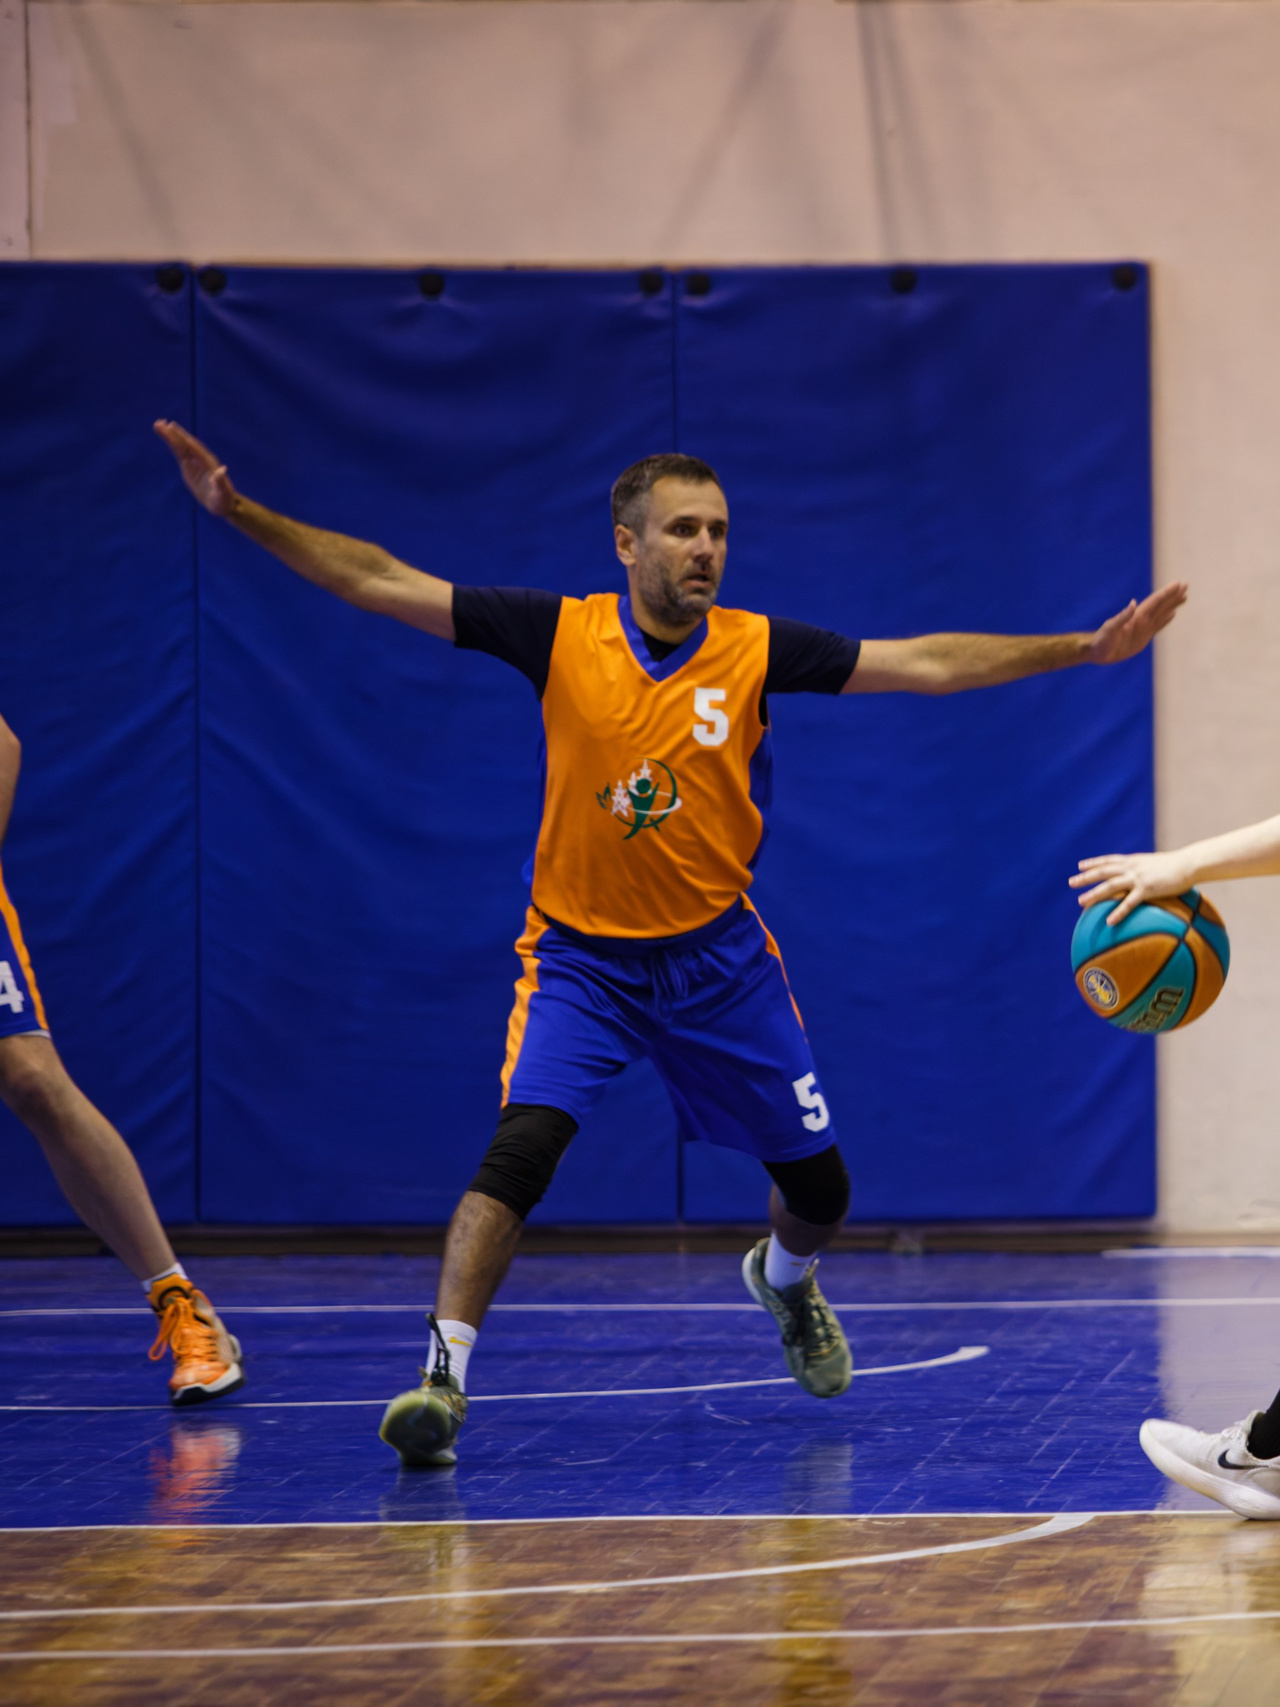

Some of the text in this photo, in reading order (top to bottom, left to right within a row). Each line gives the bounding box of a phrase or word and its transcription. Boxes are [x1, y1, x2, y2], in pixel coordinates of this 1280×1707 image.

[692, 687, 729, 746] 5
[0, 960, 25, 1014] 4
[792, 1071, 830, 1132] 5
